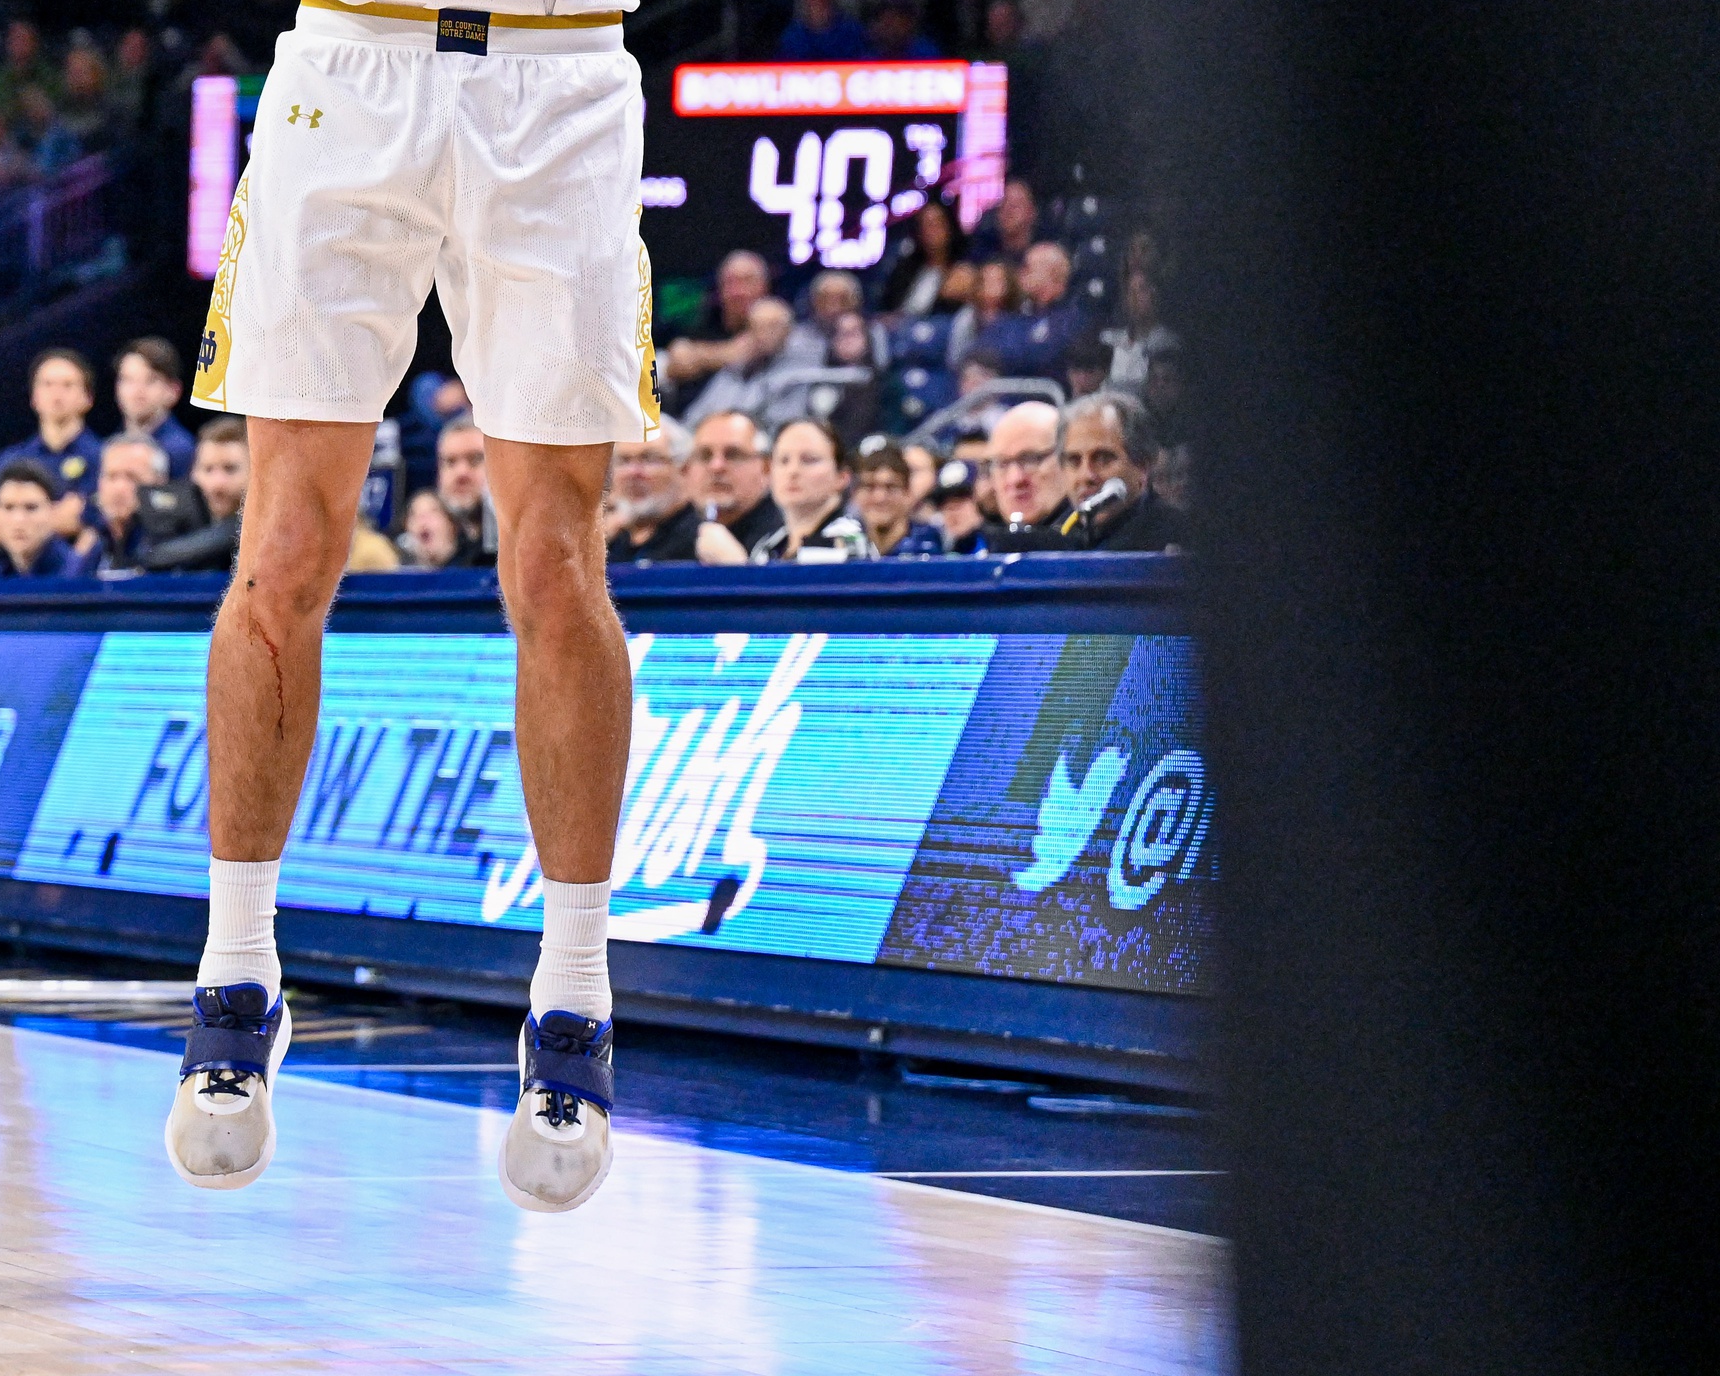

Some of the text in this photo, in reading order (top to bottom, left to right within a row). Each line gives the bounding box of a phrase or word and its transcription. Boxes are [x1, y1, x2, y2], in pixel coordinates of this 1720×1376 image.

[440, 28, 486, 42] NOTRE DAME
[681, 69, 966, 109] BOWLING GREEN
[750, 128, 894, 269] 40
[378, 720, 516, 853] THE
